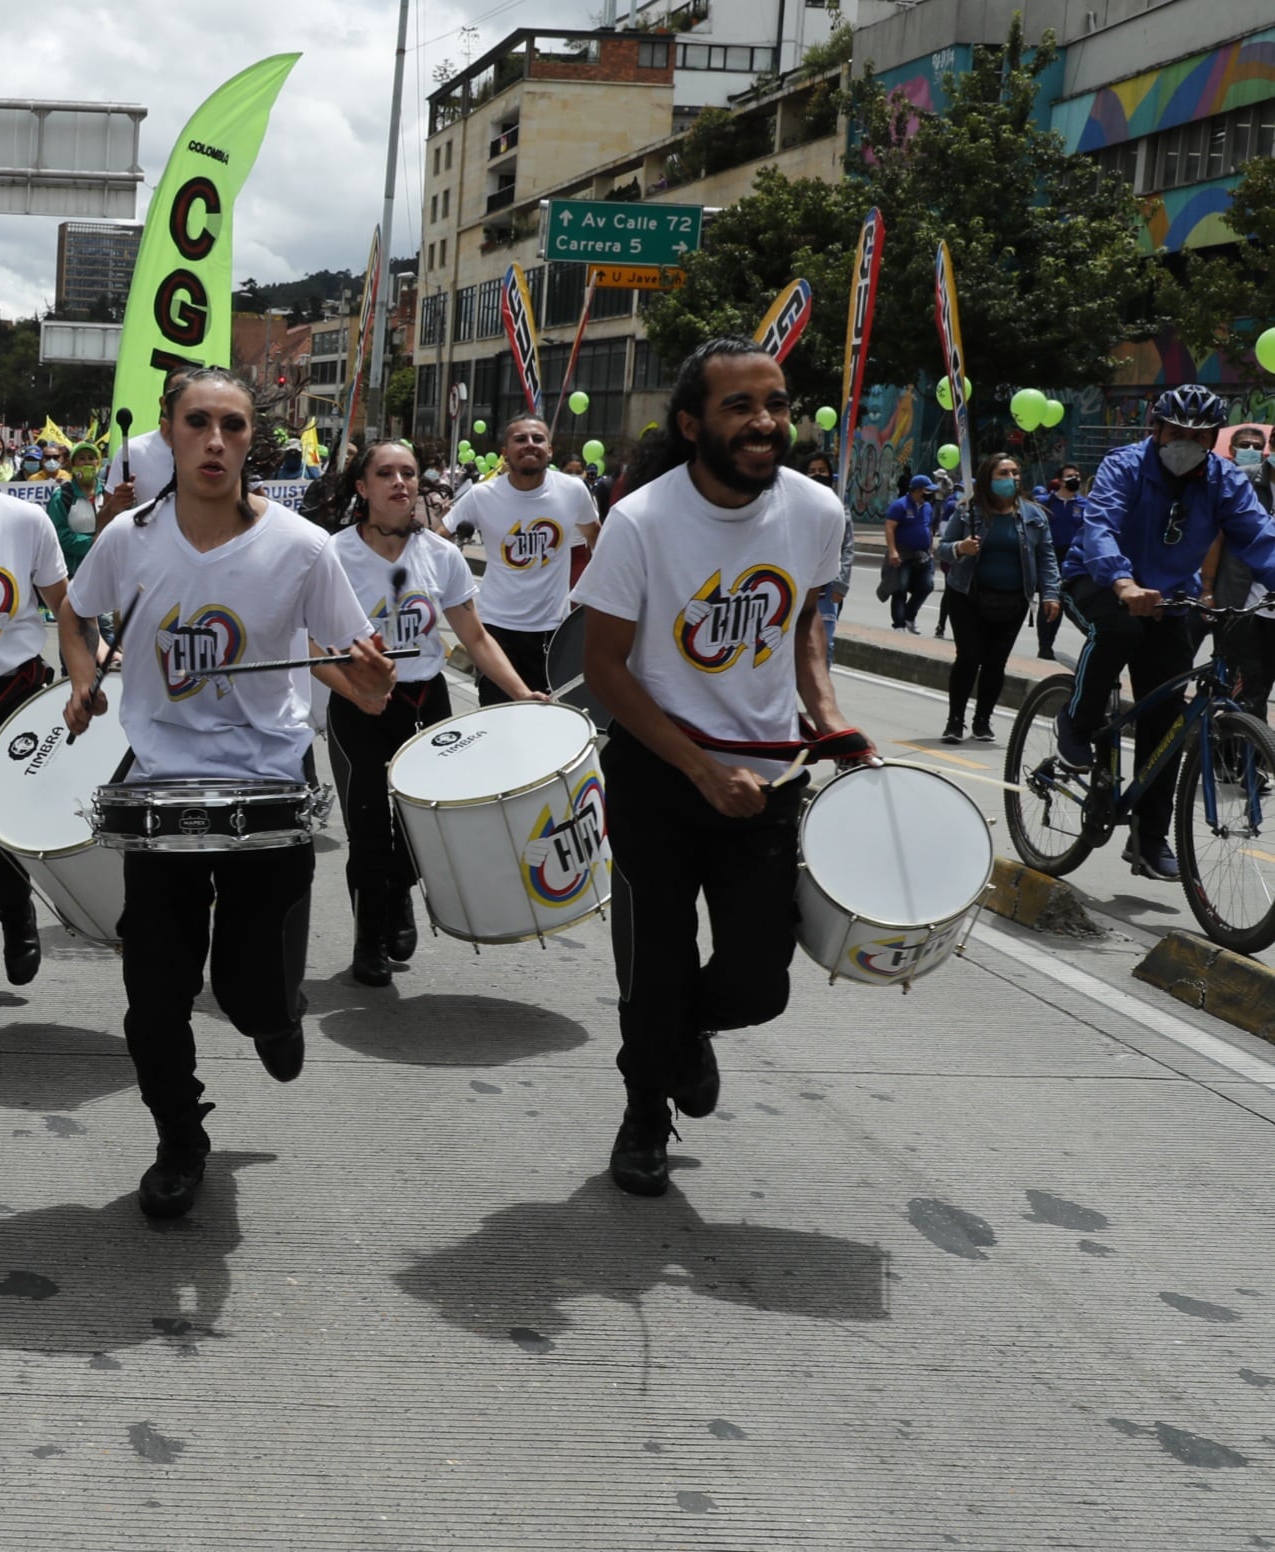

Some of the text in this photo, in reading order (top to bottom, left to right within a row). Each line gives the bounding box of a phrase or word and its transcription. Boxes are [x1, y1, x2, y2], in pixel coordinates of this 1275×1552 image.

[188, 140, 229, 165] COLOMBIA
[581, 212, 693, 232] Av Calle 72
[556, 235, 642, 254] Carrera 5
[612, 271, 622, 282] U
[706, 593, 769, 647] CUT
[169, 626, 218, 678] CUT
[24, 726, 65, 776] TIMBRA
[437, 730, 488, 757] TIMBRA
